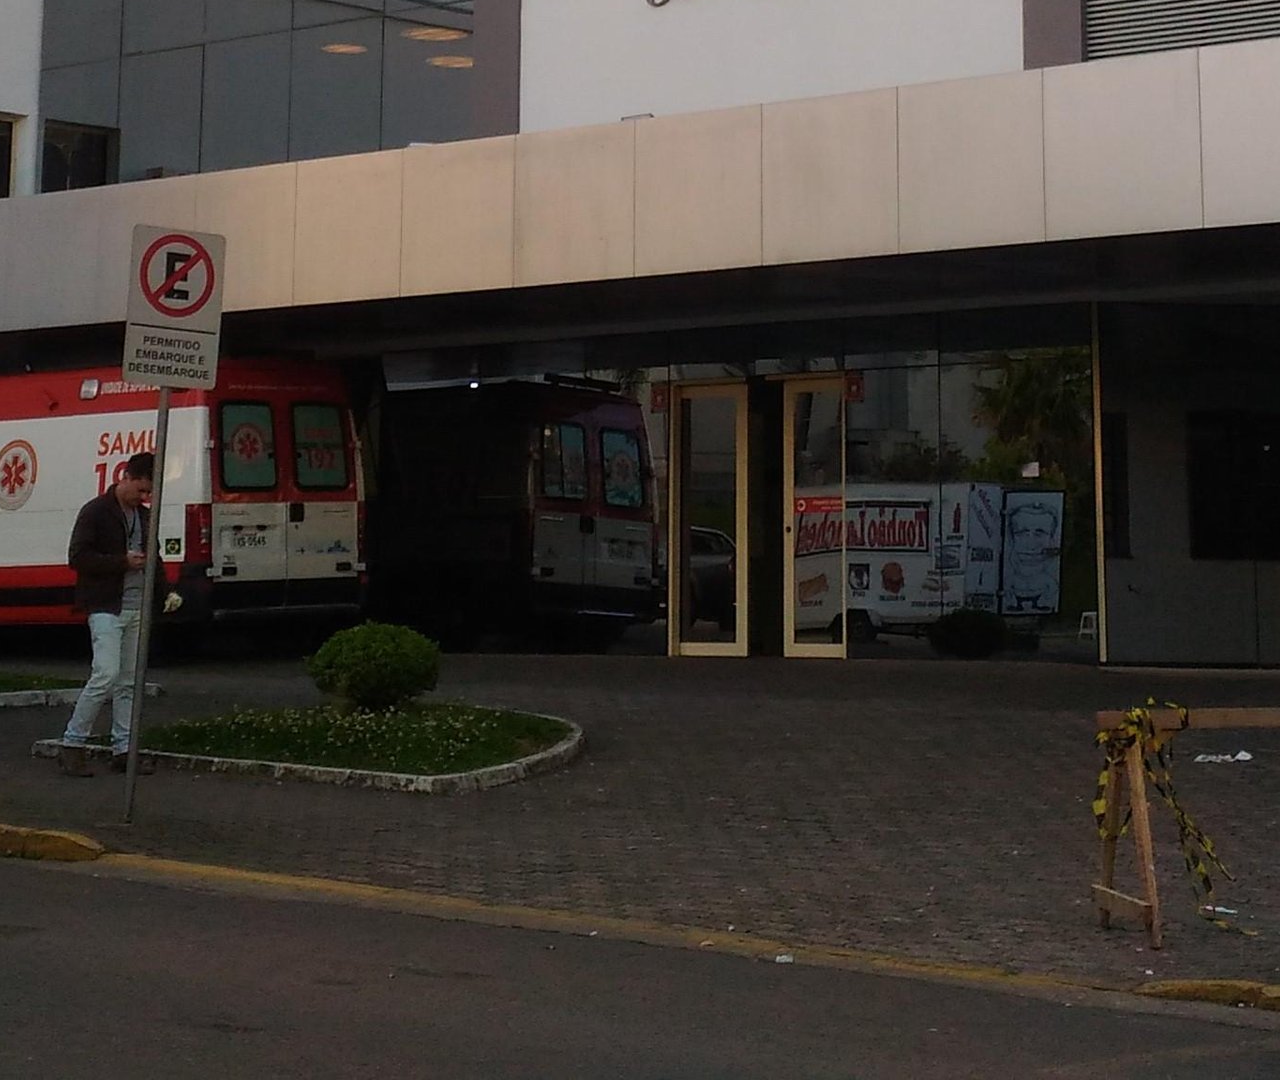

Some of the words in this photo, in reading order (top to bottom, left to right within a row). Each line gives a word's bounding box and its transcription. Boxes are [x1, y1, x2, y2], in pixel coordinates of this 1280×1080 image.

[165, 252, 191, 301] E
[143, 335, 201, 350] PERMITIDO
[135, 349, 195, 363] EMBARQUE
[198, 356, 205, 365] E
[128, 362, 209, 380] DESEMBARQUE
